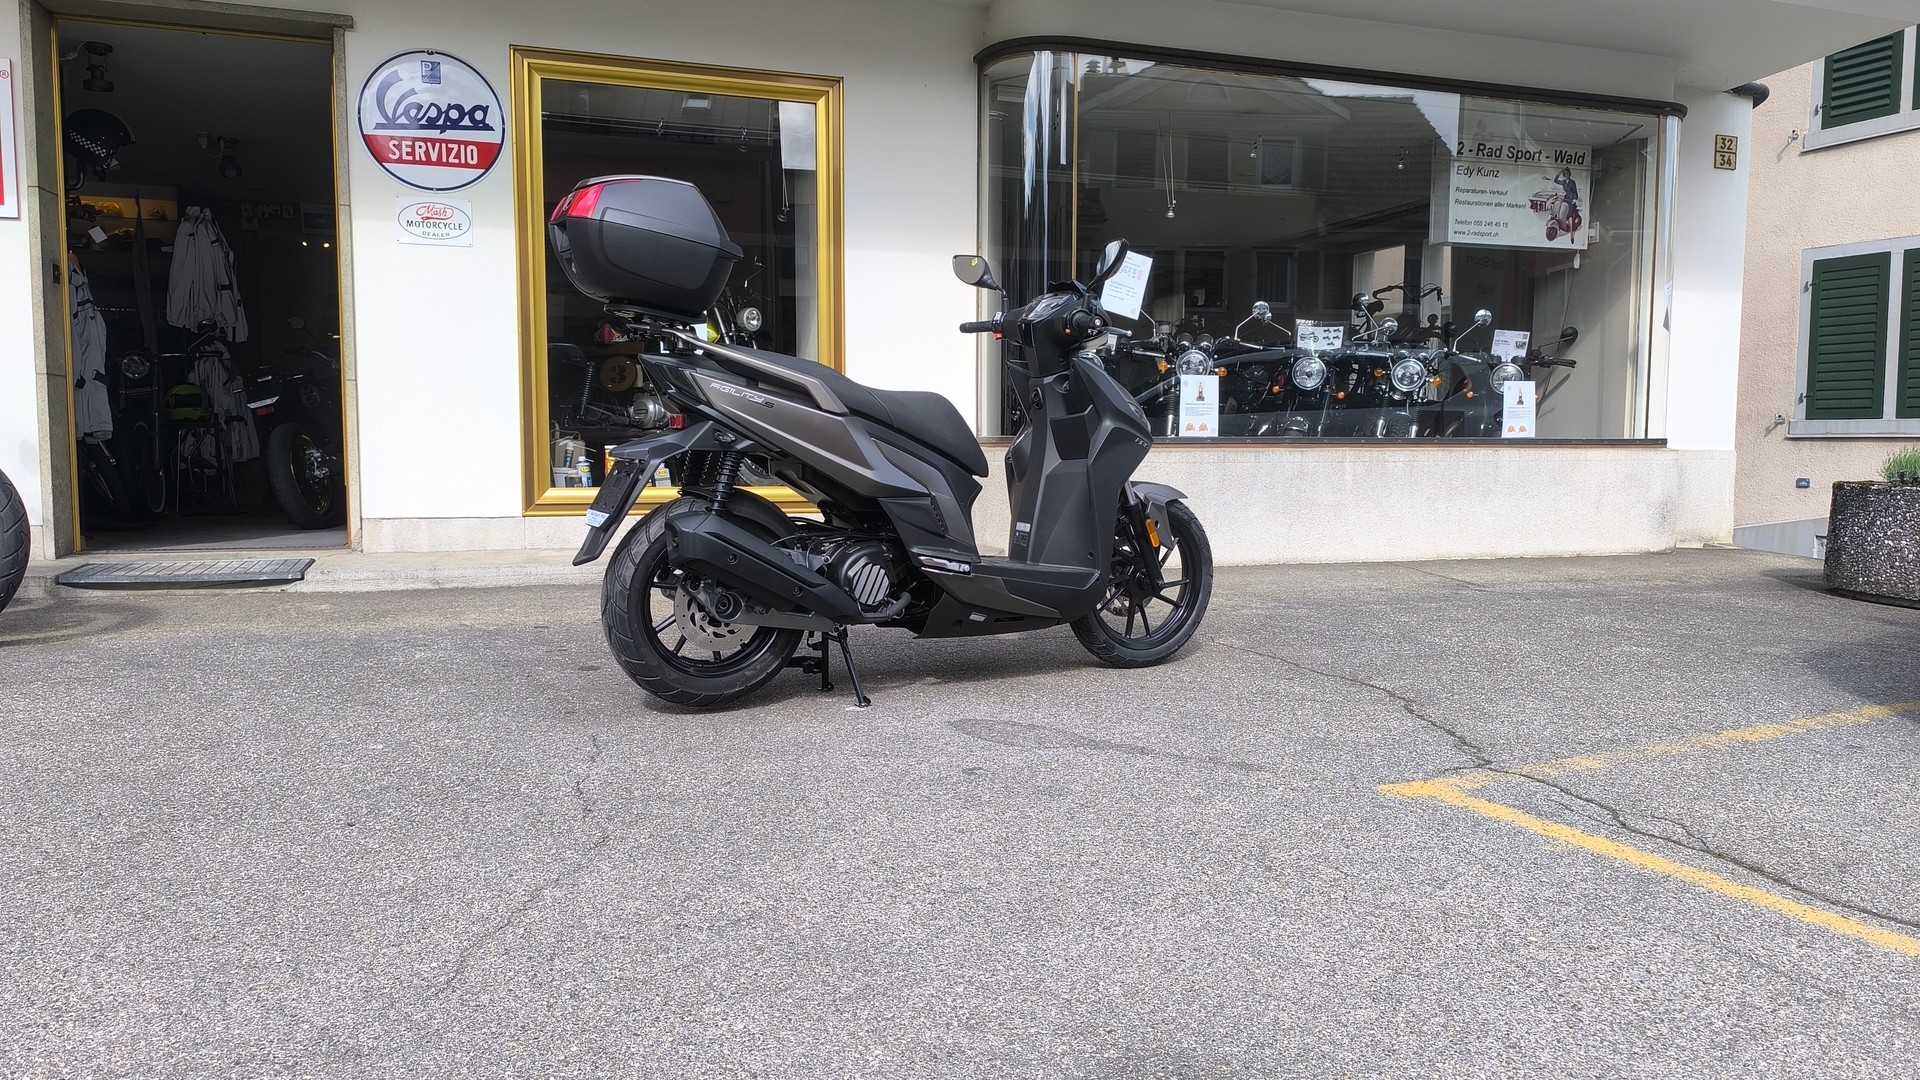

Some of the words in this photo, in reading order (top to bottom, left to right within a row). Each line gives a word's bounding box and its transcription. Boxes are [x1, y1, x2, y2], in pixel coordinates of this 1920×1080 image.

[373, 69, 495, 135] Vespa
[1720, 137, 1733, 151] 32
[388, 139, 478, 165] SERVIZIO
[1456, 141, 1465, 155] 2
[1476, 143, 1503, 158] Rad
[1506, 146, 1542, 163] Sport
[1554, 150, 1586, 165] Wald
[1719, 154, 1732, 167] 34
[1456, 165, 1474, 178] Edy
[1476, 167, 1500, 178] Kunz
[1455, 187, 1508, 196] Reparaturen-Verkauf
[1455, 199, 1493, 207] Restaurationen
[416, 204, 453, 220] Mash
[406, 219, 463, 231] MOTORCYCLE
[421, 230, 450, 238] DEALER
[1453, 230, 1499, 238] www.2-radsport.ch
[709, 382, 765, 403] AGILITY
